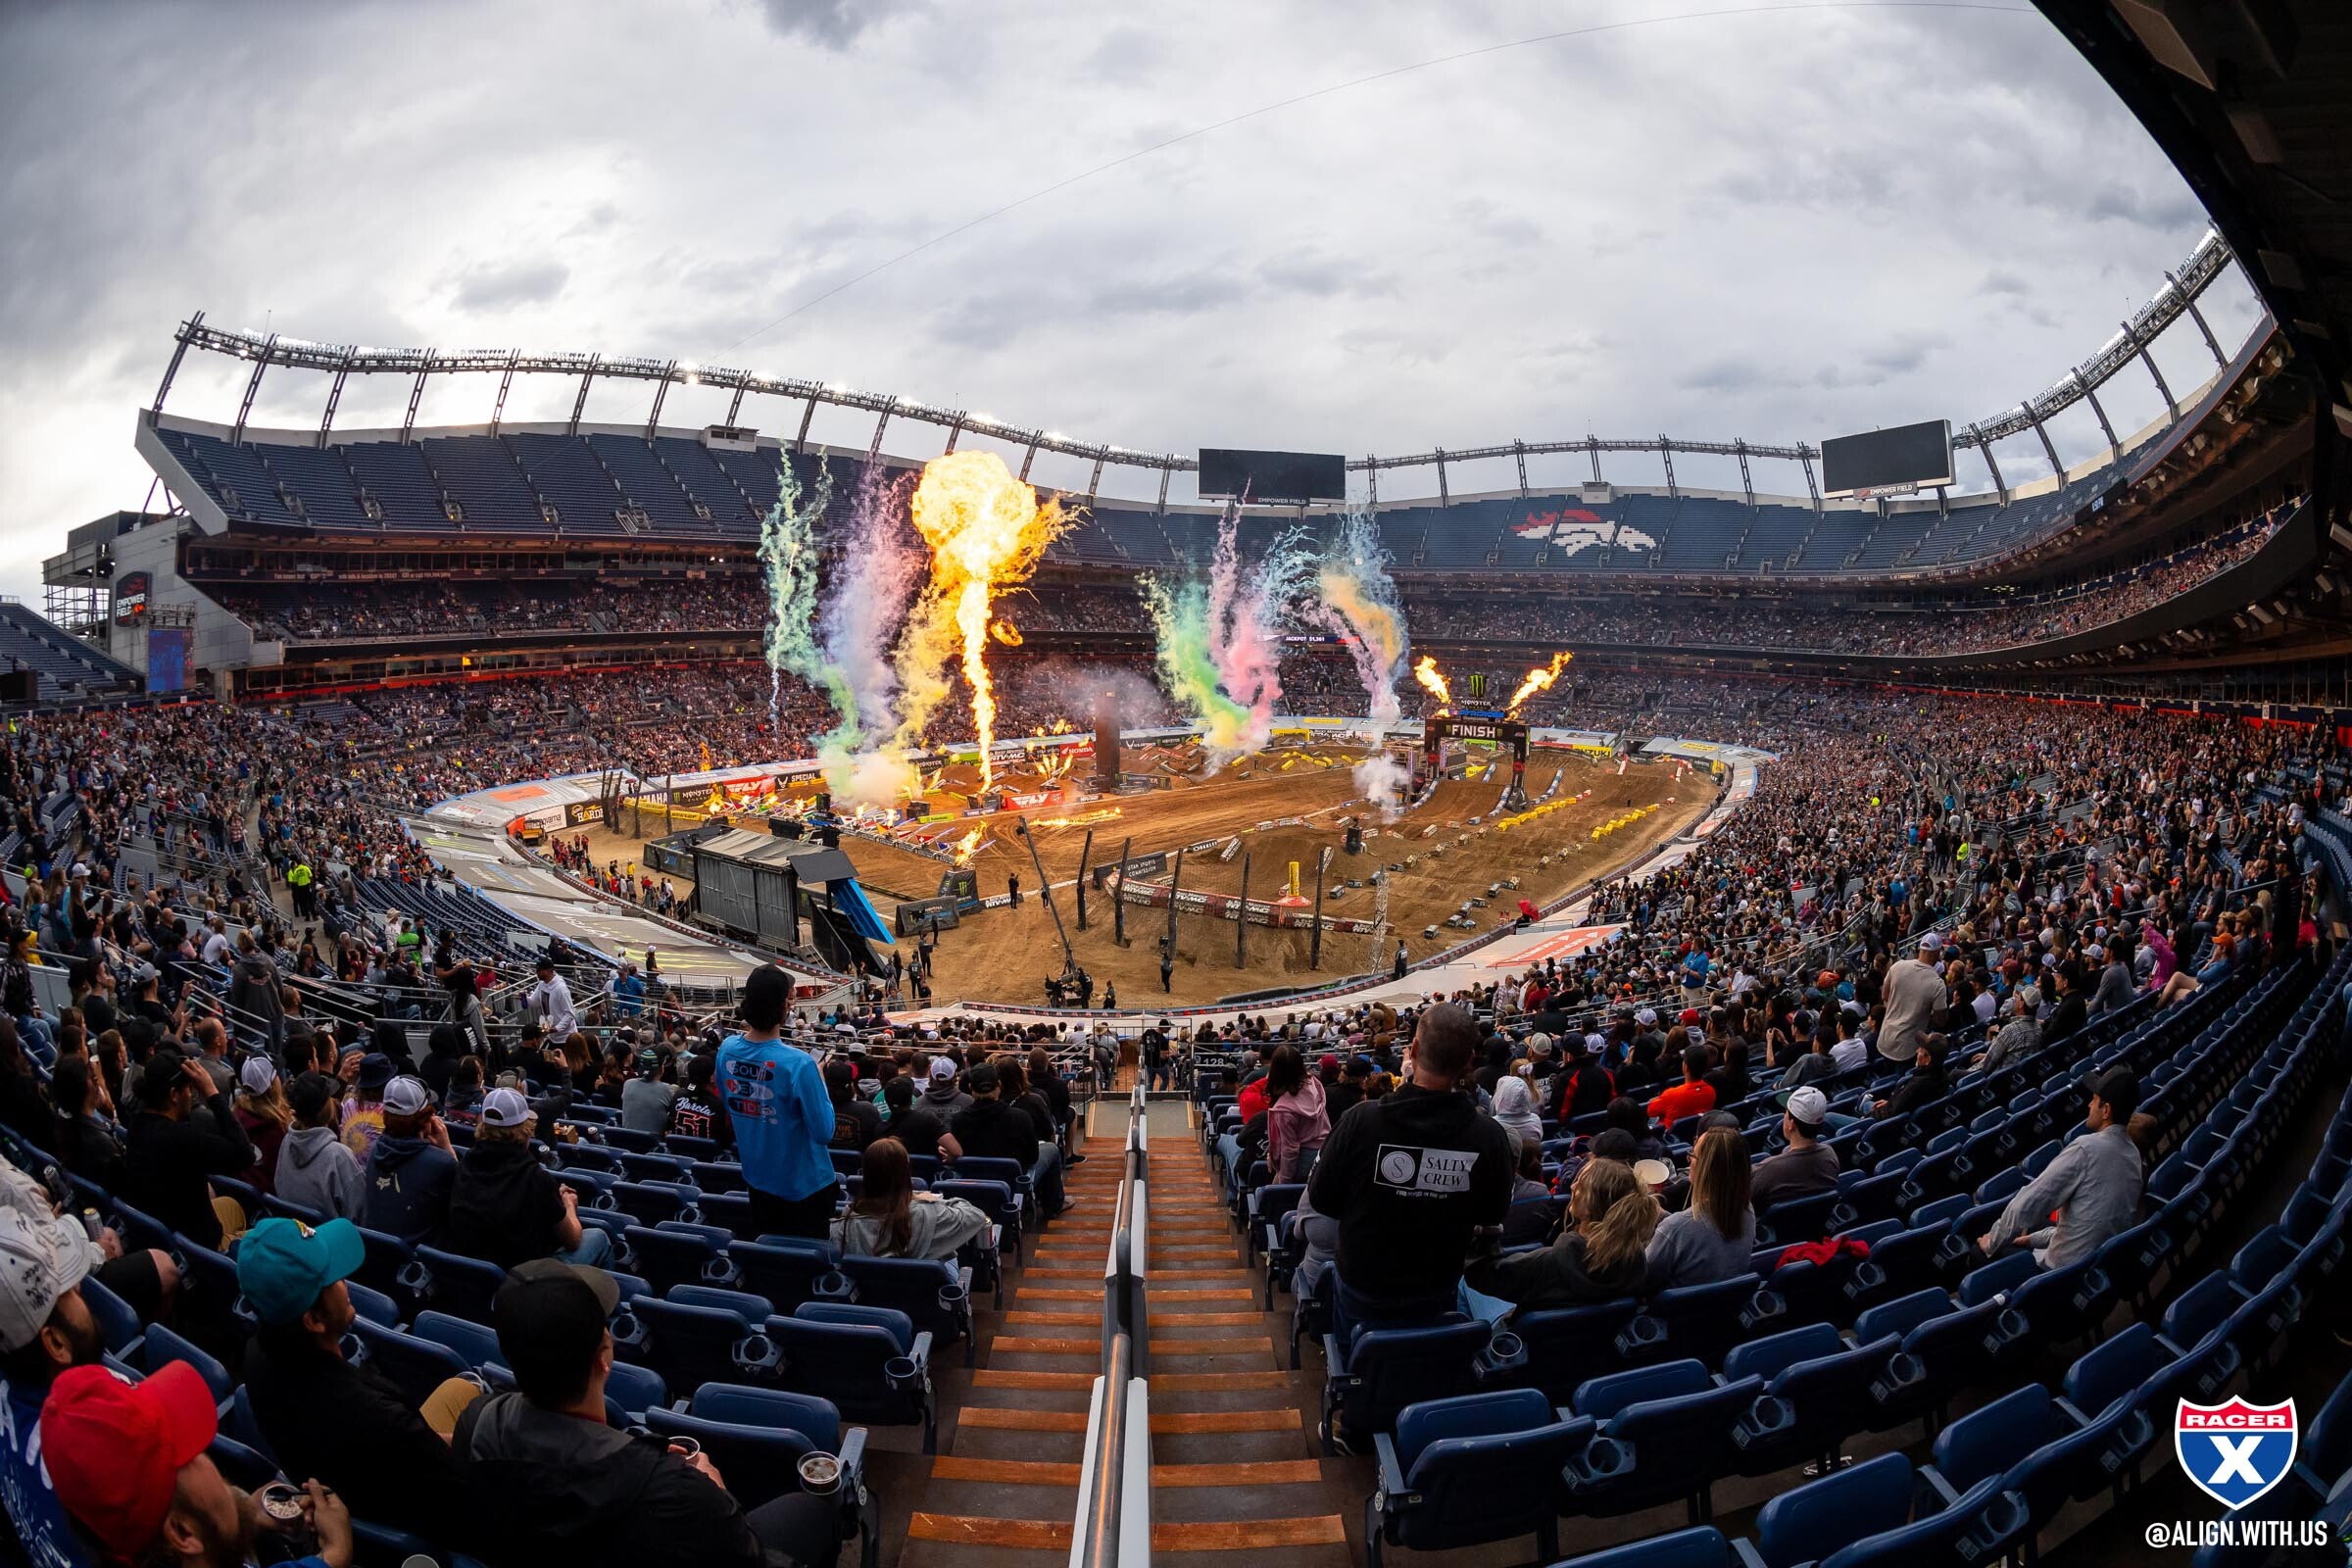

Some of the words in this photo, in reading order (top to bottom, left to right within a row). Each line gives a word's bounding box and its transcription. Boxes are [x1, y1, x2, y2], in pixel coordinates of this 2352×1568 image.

[117, 593, 146, 609] EMPOWER
[1451, 724, 1495, 738] FINISH
[791, 772, 816, 783] SPECIAL
[682, 788, 714, 799] MONSTER
[675, 1097, 716, 1116] Barcia
[675, 1110, 710, 1138] 51
[1425, 1156, 1468, 1172] SALTY
[1423, 1172, 1463, 1187] CREW
